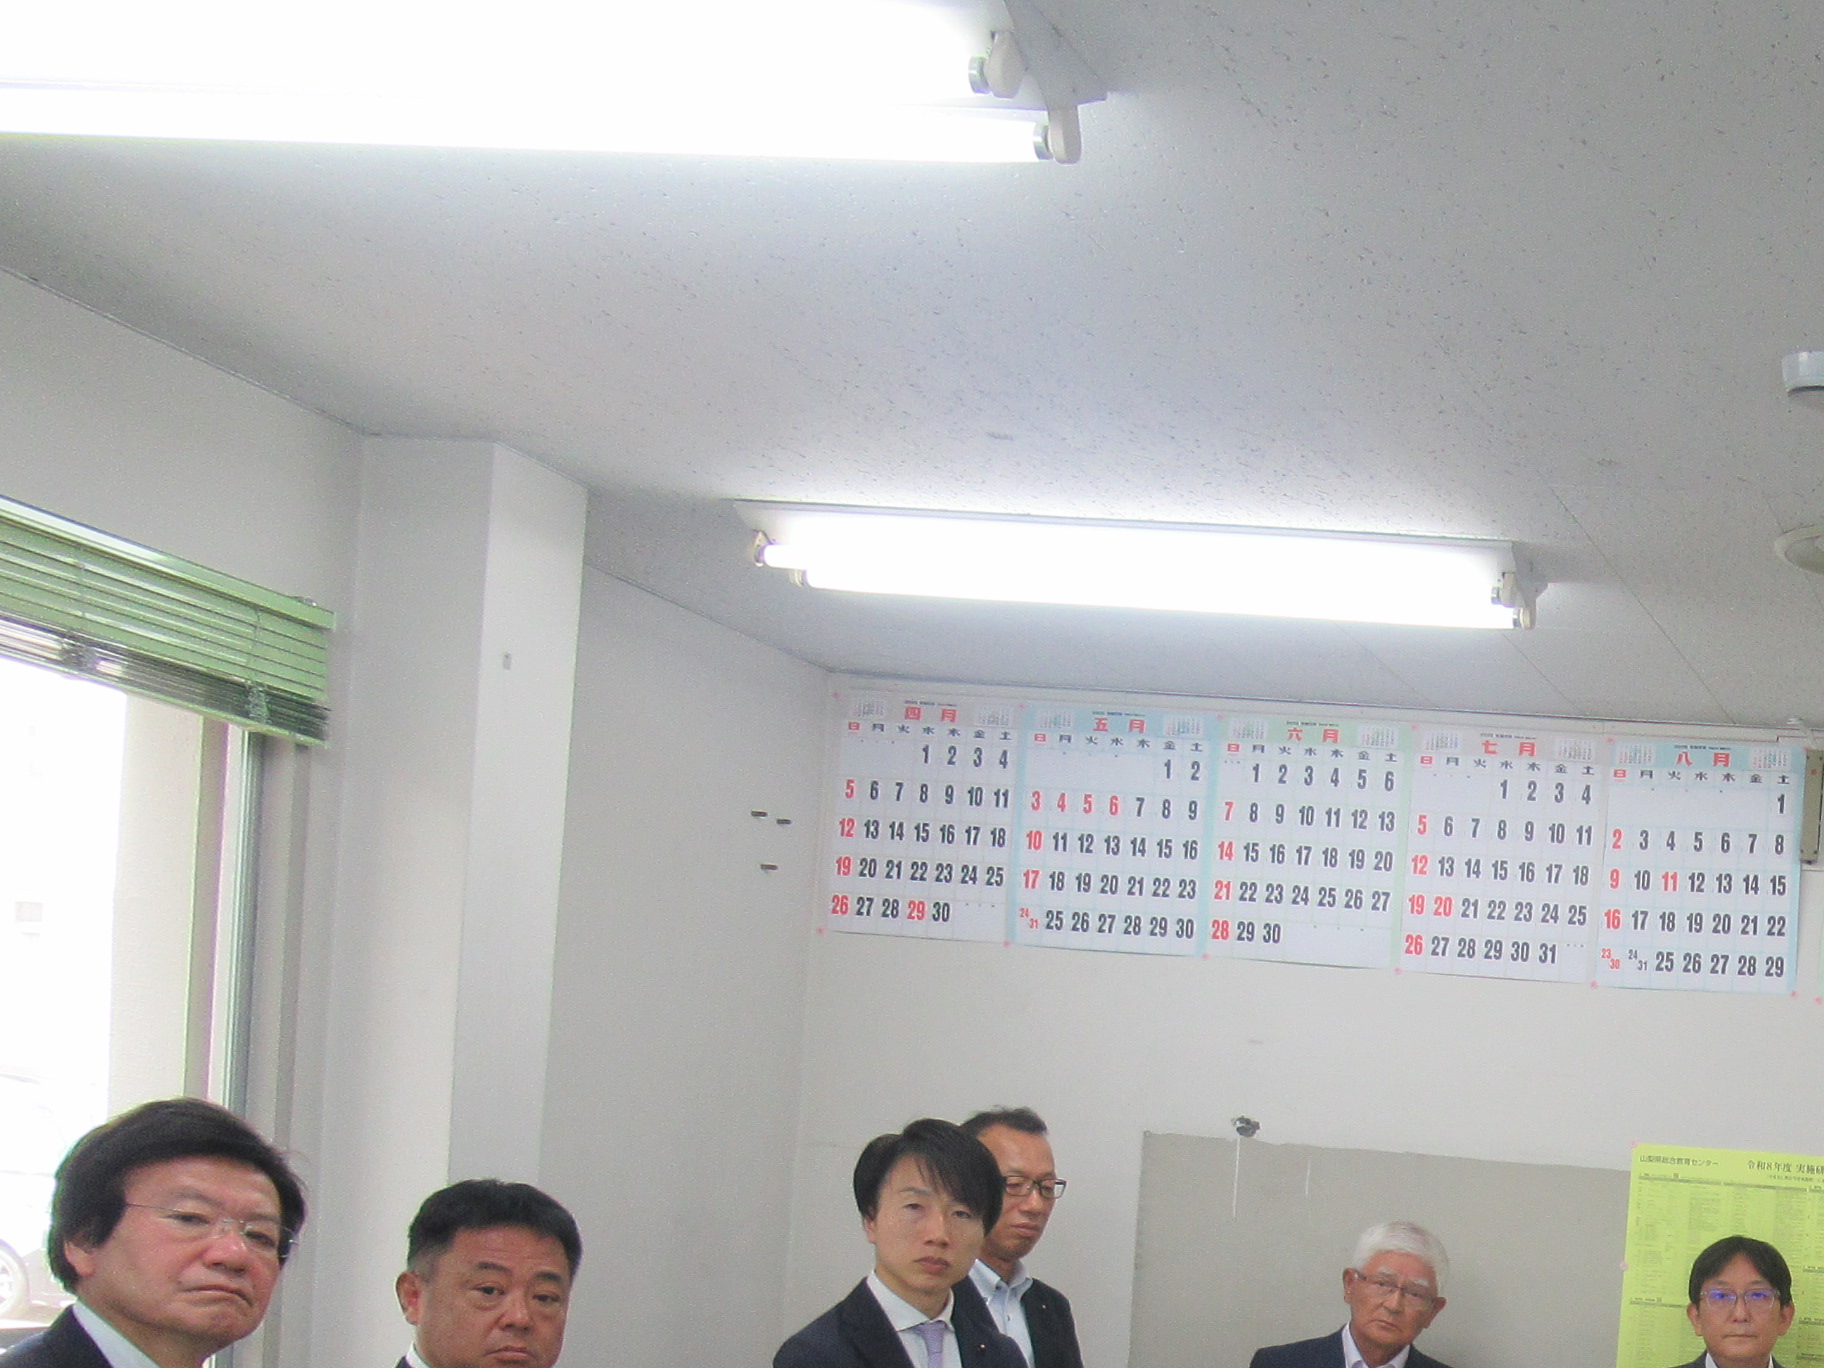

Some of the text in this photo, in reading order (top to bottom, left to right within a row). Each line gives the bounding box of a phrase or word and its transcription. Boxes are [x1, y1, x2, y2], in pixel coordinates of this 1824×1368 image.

[1252, 762, 1395, 792] 1 2 3 4 5 6
[844, 778, 1009, 809] 5 6 7 8 9 10 11
[1025, 830, 1199, 861] 10 11 12 13 14 15 16
[835, 856, 1004, 887] 19 20 21 22 23 24 25
[1411, 854, 1589, 886] 12 13 14 15 16 17 18
[1609, 868, 1787, 897] 9 10 11 12 13 14 15
[1213, 879, 1391, 912] 21 22 23 24 25 26 27
[1045, 909, 1194, 940] 25 26 27 28 29 30
[1601, 948, 1611, 959] 23
[1610, 958, 1620, 970] 30
[1628, 949, 1638, 960] 24
[1638, 960, 1647, 971] 31
[1655, 950, 1785, 978] 25 26 27 28 29
